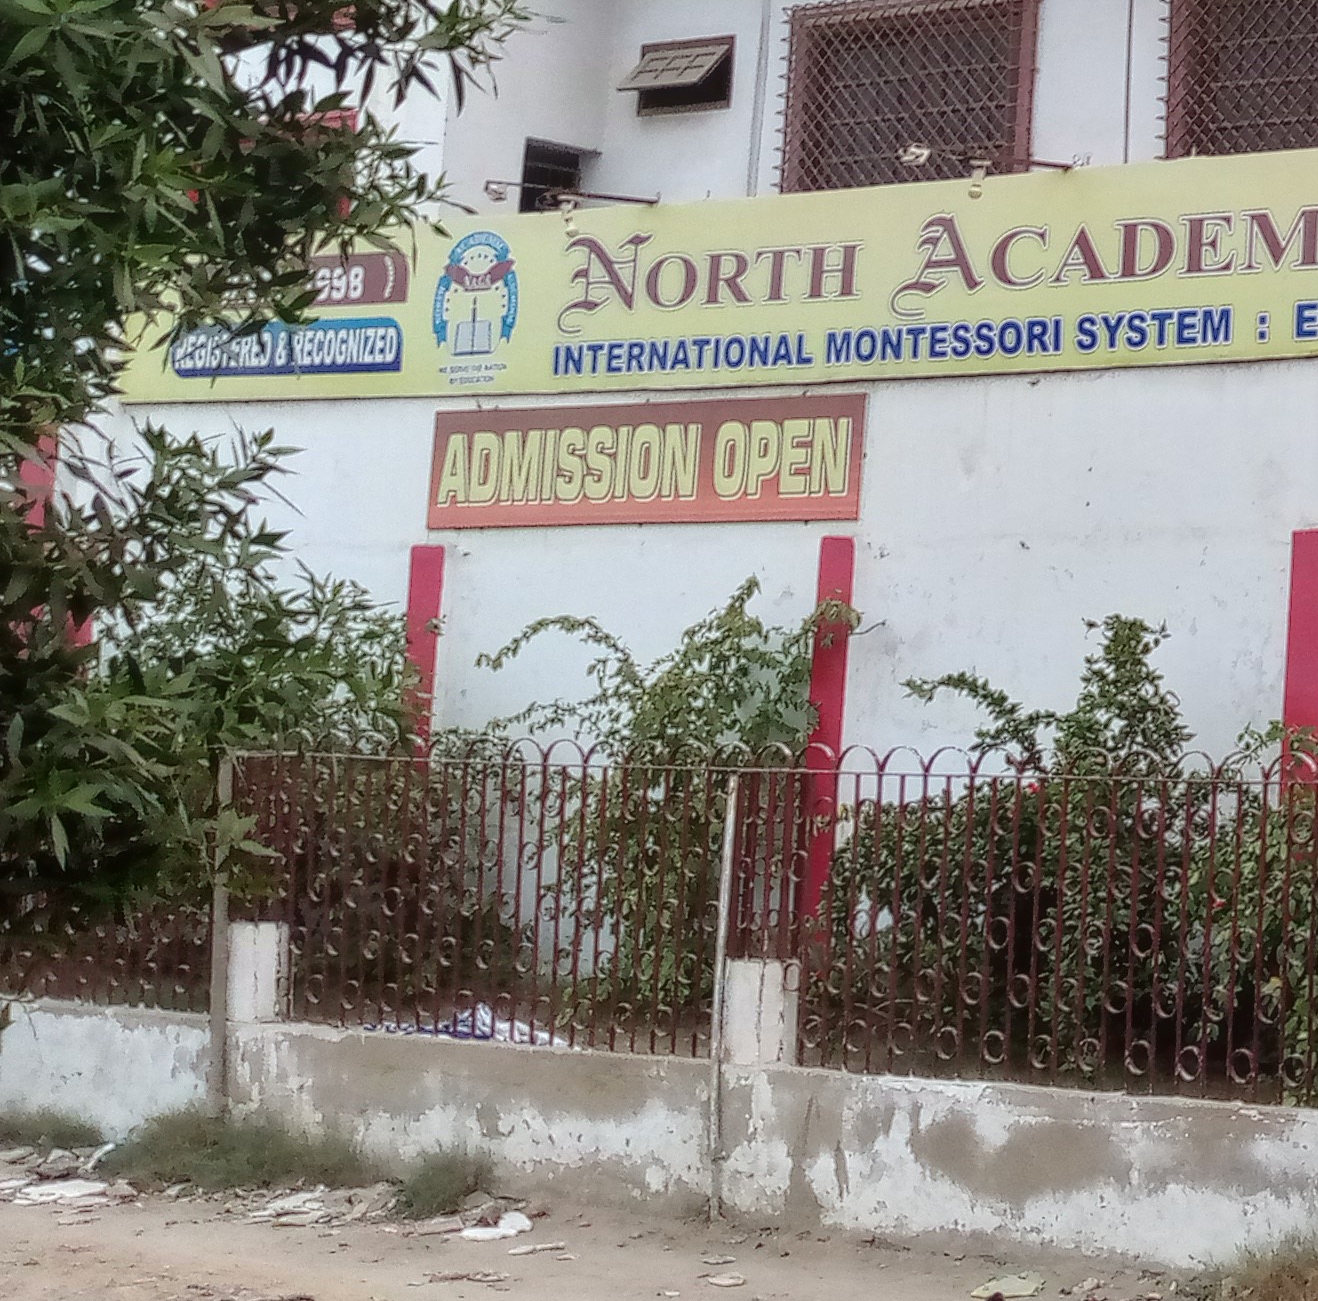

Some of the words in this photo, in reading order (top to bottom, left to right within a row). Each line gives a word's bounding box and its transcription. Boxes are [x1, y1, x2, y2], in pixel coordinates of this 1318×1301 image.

[275, 331, 287, 368] &
[292, 326, 398, 366] RECOGNIZED
[552, 332, 813, 377] INTERNATIONAL
[825, 315, 1061, 368] MONTESSORI
[1073, 305, 1232, 354] SYSTEM
[437, 421, 702, 508] ADMISSION
[712, 417, 853, 500] OPEN
